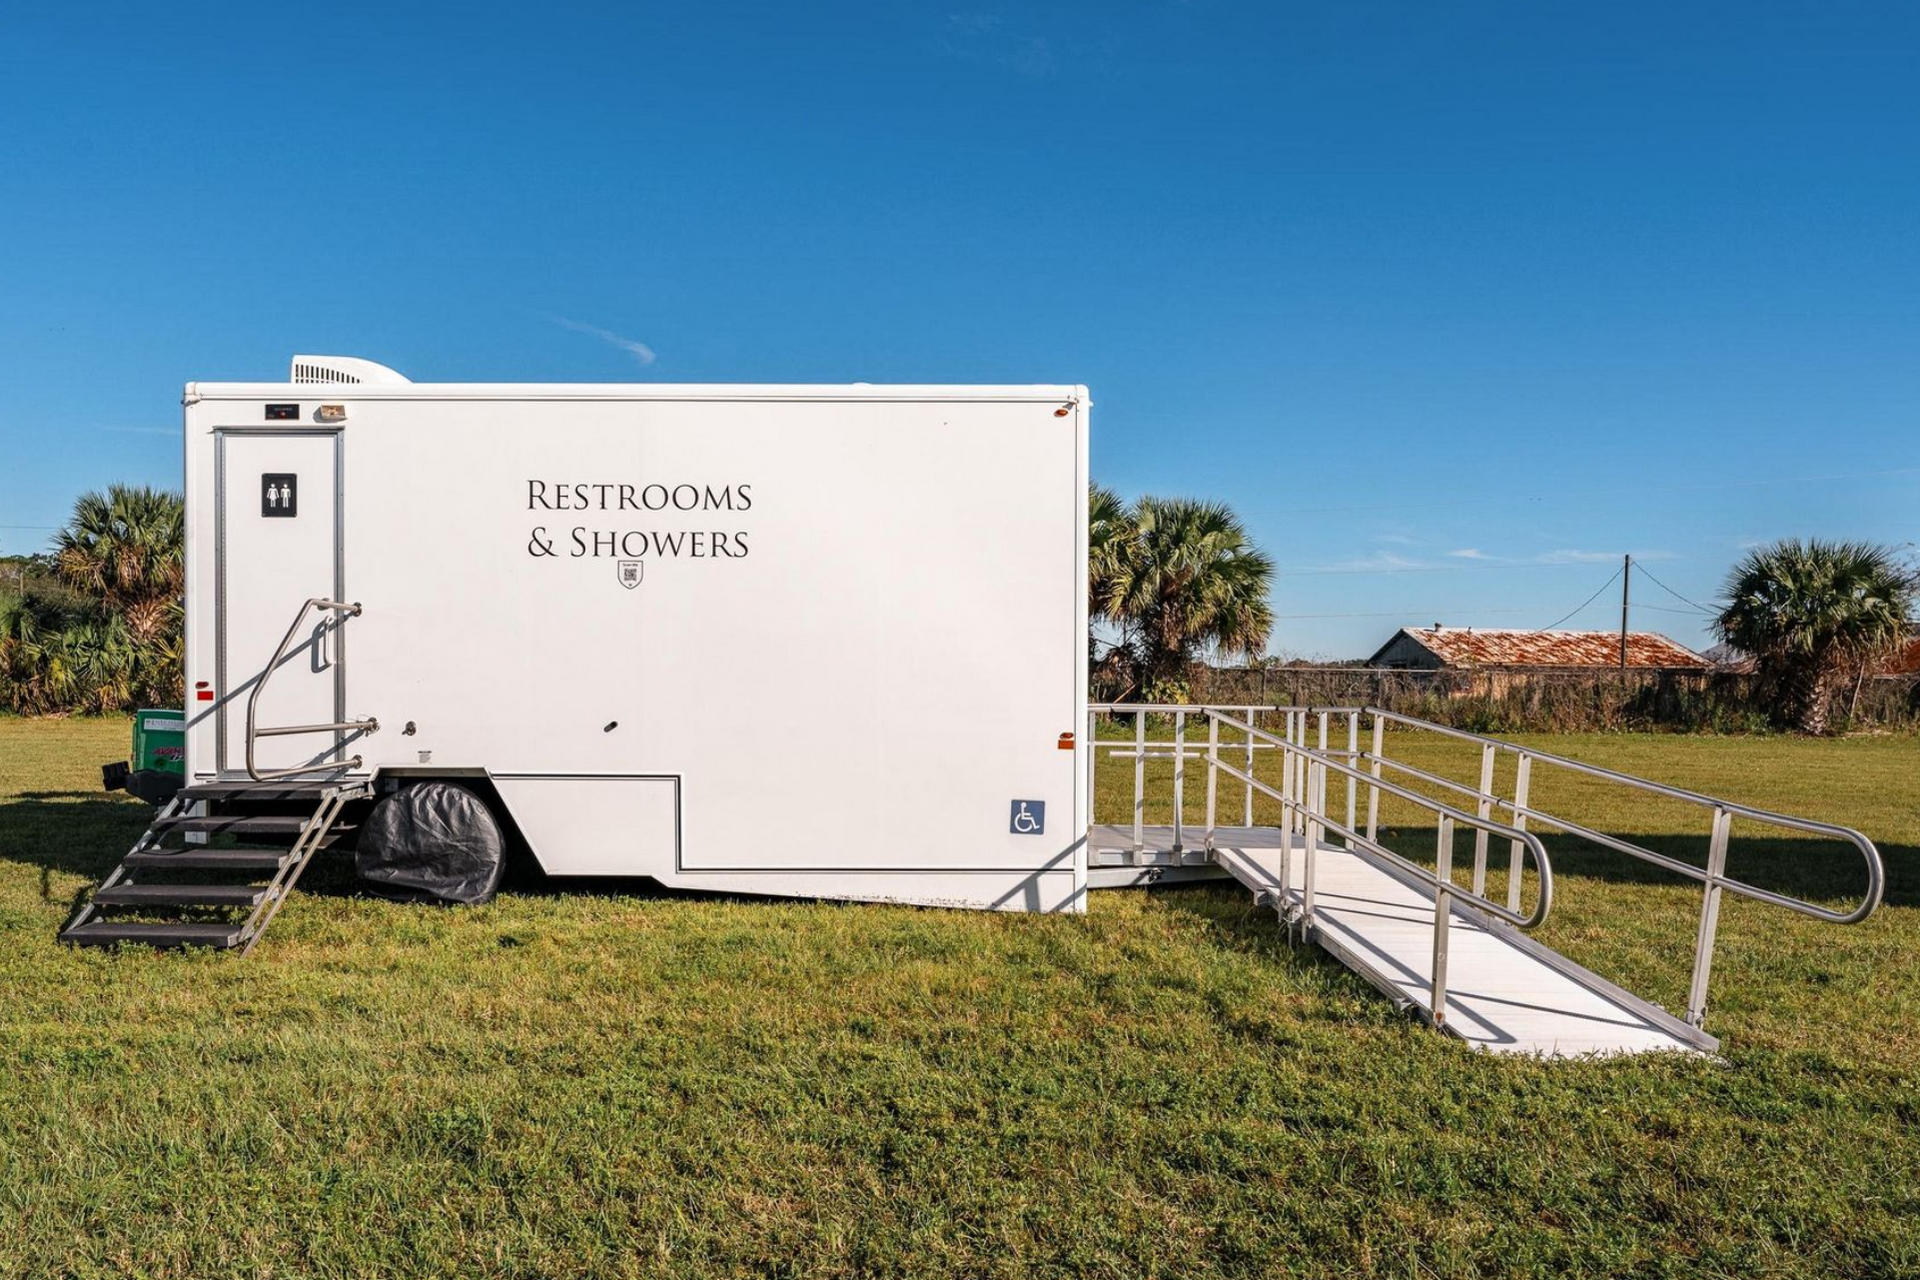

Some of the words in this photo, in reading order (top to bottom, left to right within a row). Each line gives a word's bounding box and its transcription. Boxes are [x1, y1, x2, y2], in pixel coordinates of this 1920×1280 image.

[527, 479, 752, 511] RESTROOMS
[527, 526, 559, 558] &
[570, 526, 749, 558] SHOWERS
